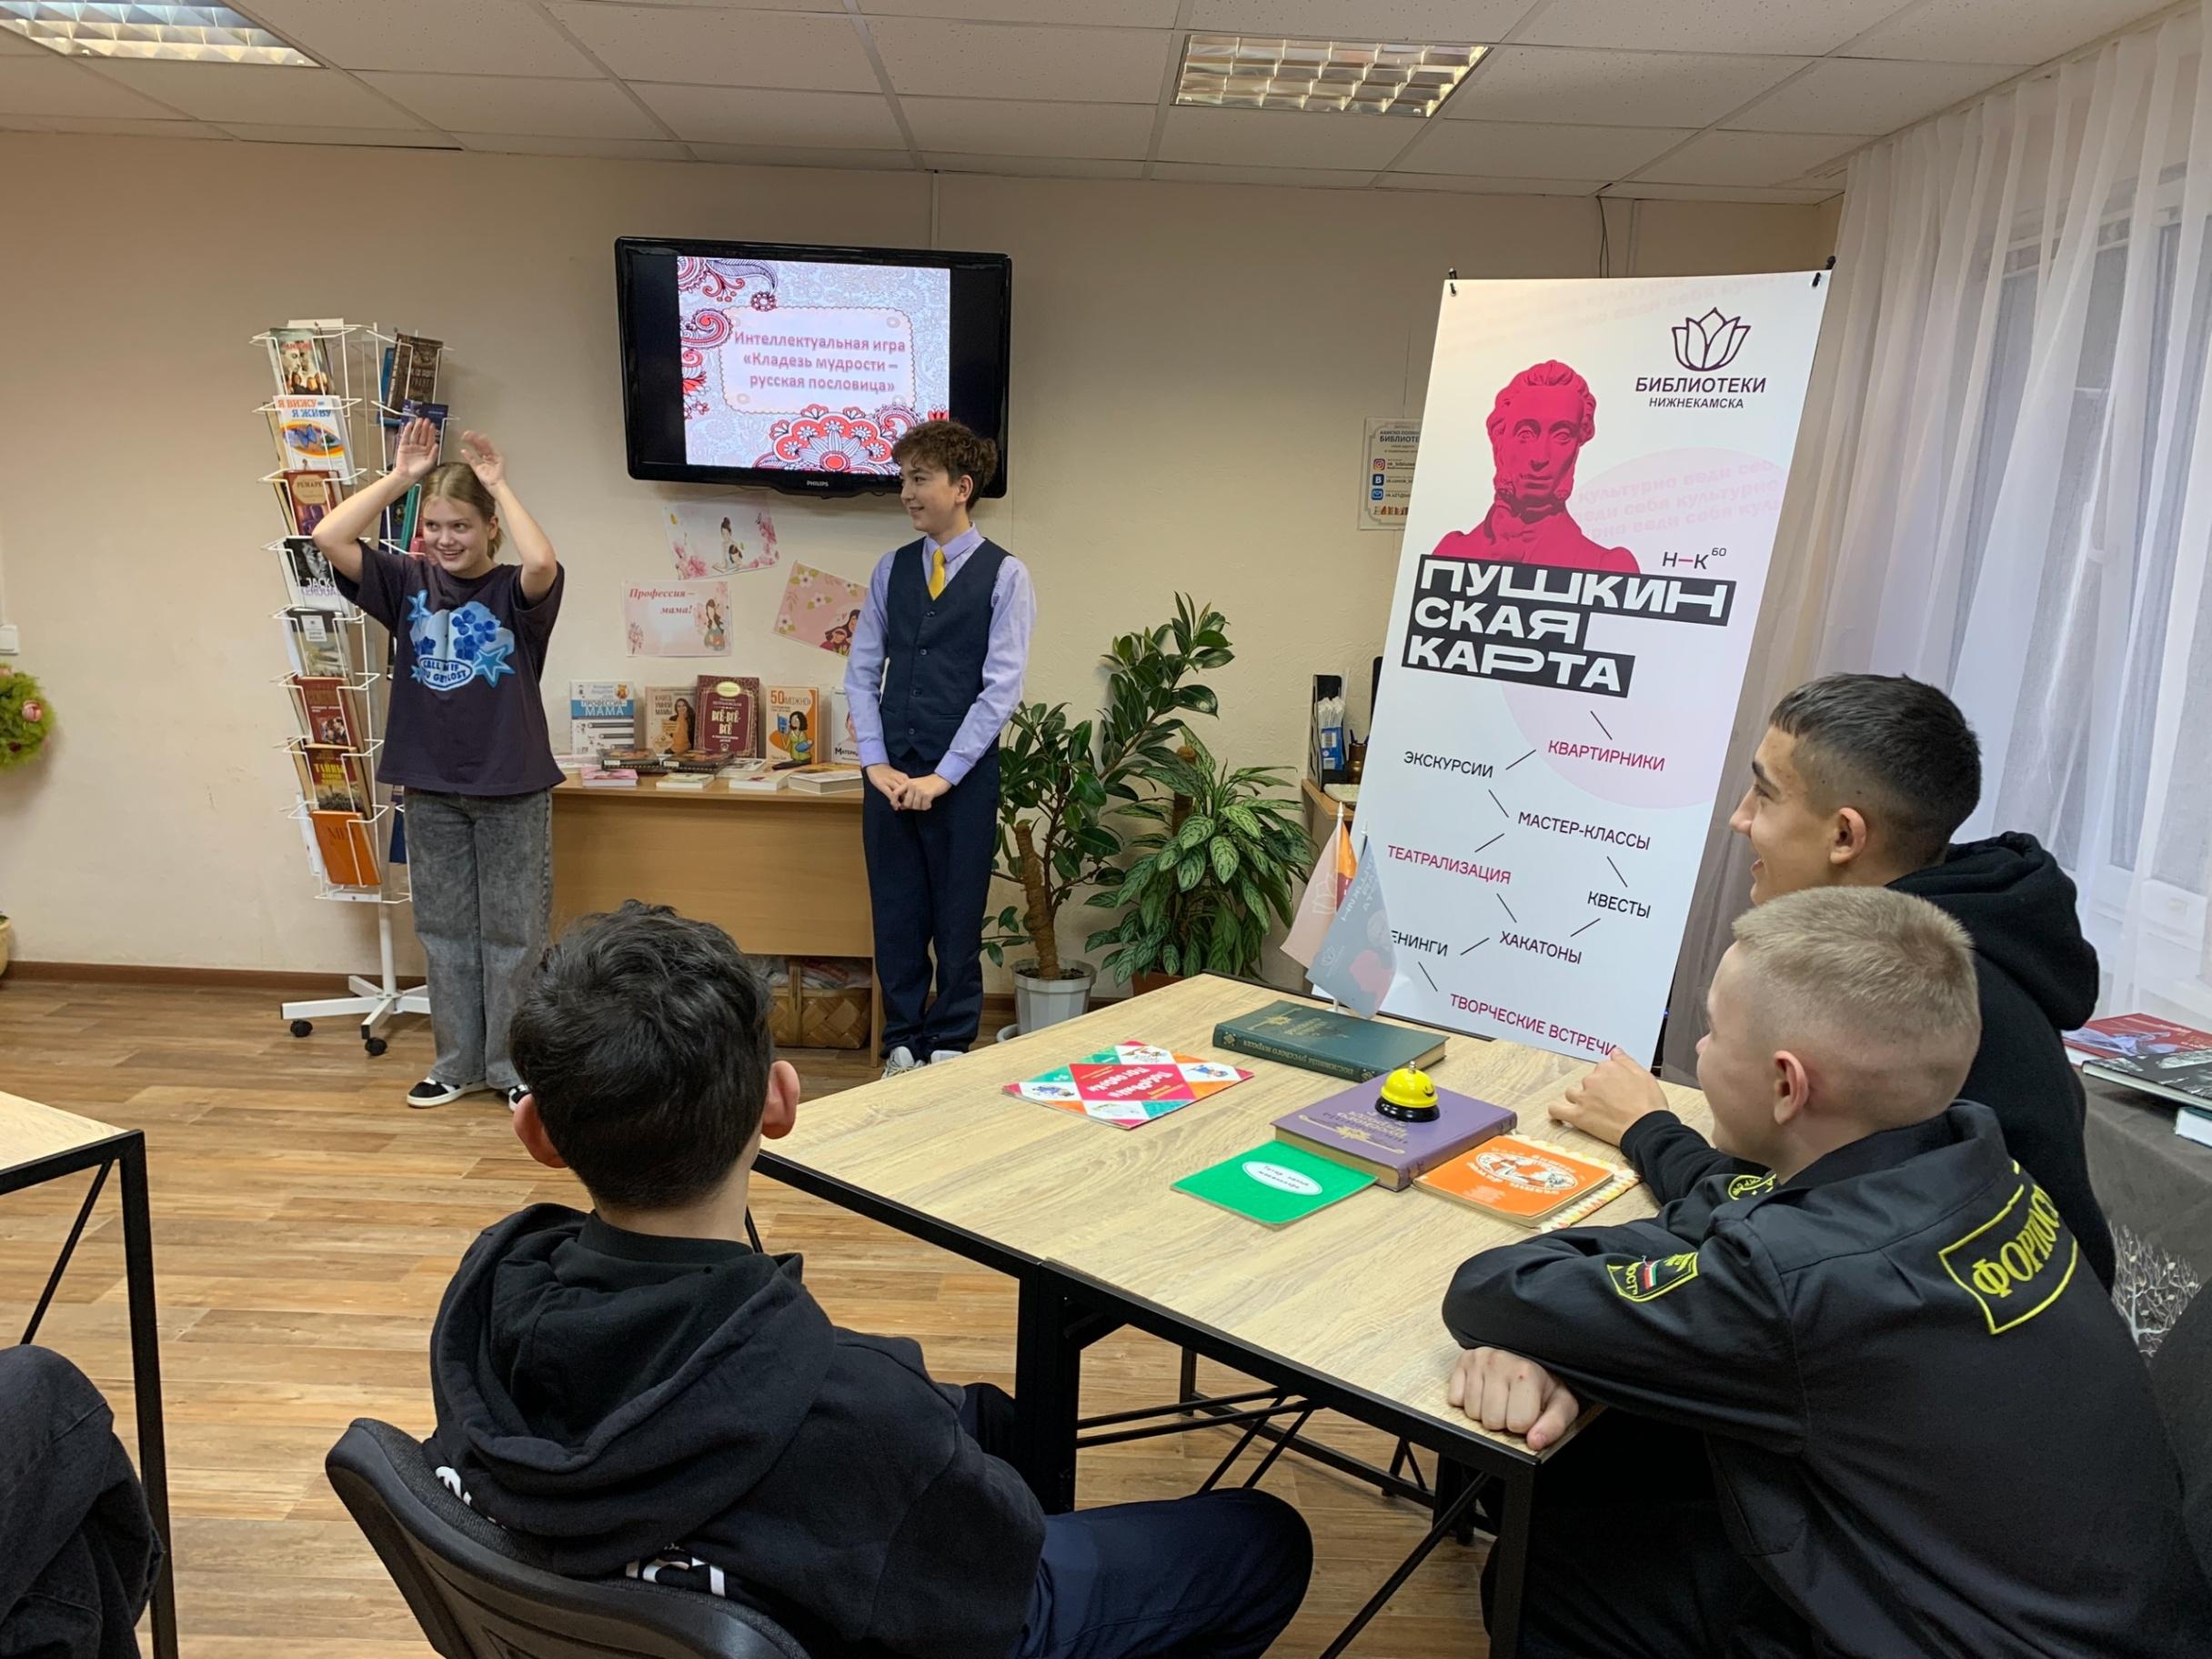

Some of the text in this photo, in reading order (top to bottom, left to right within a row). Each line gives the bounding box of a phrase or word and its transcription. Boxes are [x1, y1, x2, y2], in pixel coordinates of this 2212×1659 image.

[735, 331, 906, 355] Интеллектуальная игра
[743, 352, 812, 369] «Кладезь
[816, 359, 886, 373] мудрости
[750, 375, 895, 395] русская пословица»
[1635, 377, 1766, 393] БИБЛИОТЕКИ
[287, 400, 317, 408] ВИЖУ
[311, 409, 340, 417] ЖИВУ
[1649, 397, 1744, 408] НИЖНЕКАМСКА
[1624, 498, 1670, 517] себя
[1633, 515, 1680, 534] веди
[1685, 505, 1733, 525] себя
[629, 588, 686, 600] Профессия
[1421, 559, 1727, 618] ПУШКИН
[660, 605, 692, 614] мама!
[1414, 597, 1581, 644] СКАЯ
[423, 660, 440, 669] CALL
[1407, 635, 1621, 691] КАРТА
[770, 690, 784, 705] 50
[585, 706, 625, 717] МАМА
[1404, 750, 1493, 778] ЭКСКУРСИИ
[1548, 740, 1665, 771] КВАРТИРНИКИ
[1518, 811, 1650, 850] МАСТЕР-КЛАССЫ
[1388, 845, 1511, 884] ТЕАТРАЛИЗАЦИЯ
[1587, 891, 1651, 918] КВЕСТЫ
[1500, 930, 1583, 964] ХАКАТОНЫ
[1450, 993, 1616, 1056] ТВОРЧЕСКИЕ ВСТРЕЧИ
